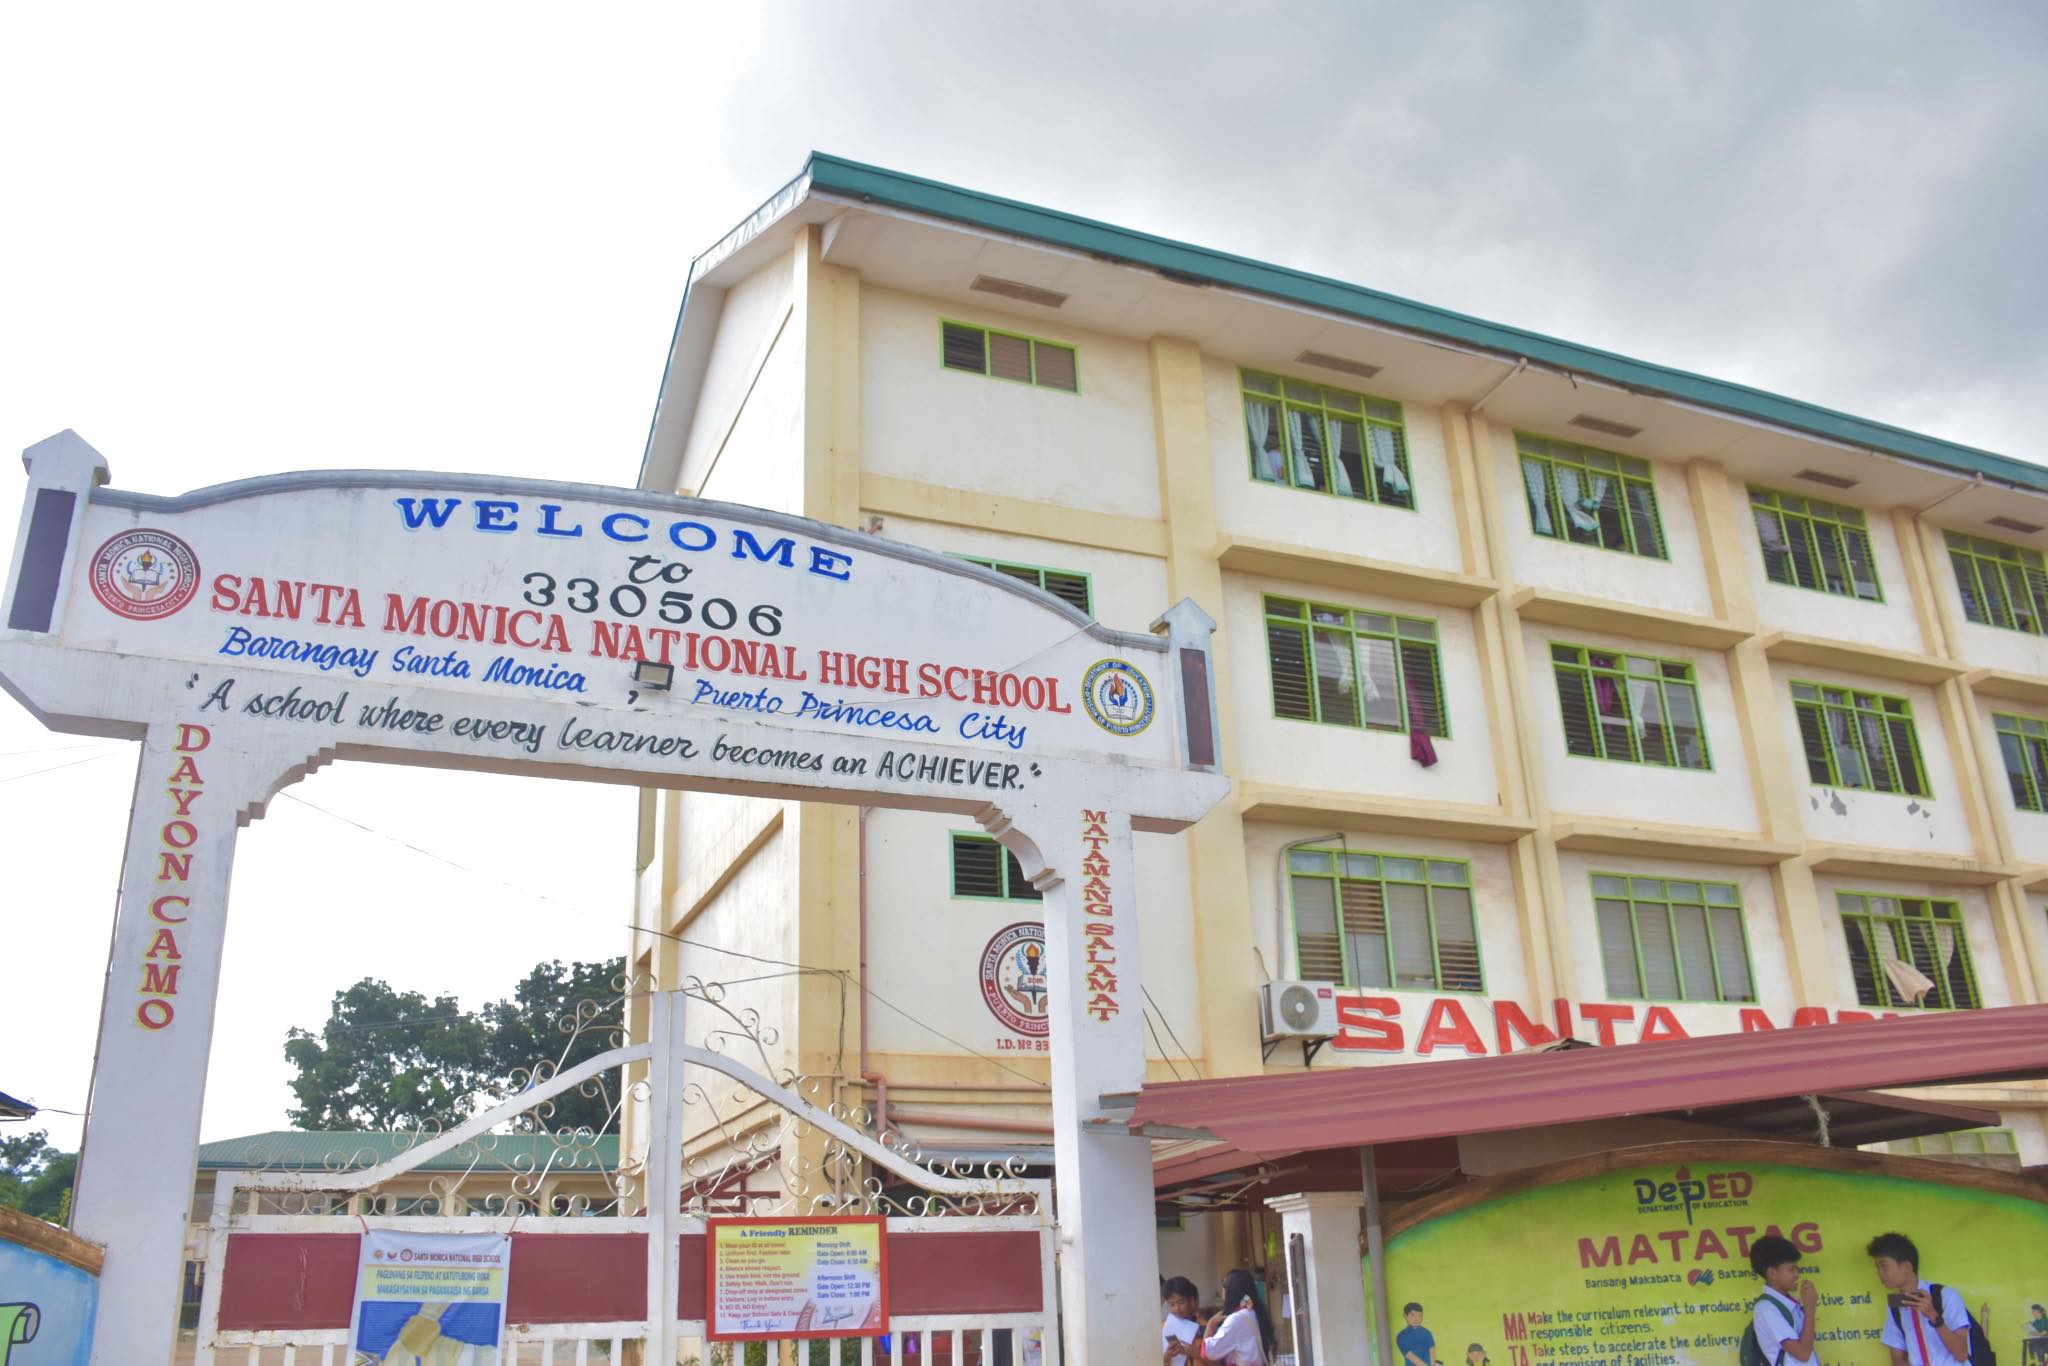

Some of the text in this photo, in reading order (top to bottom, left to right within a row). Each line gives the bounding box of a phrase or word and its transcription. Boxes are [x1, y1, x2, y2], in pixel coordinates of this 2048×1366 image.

[104, 538, 131, 561] MONICA
[131, 534, 173, 549] NATIONAL
[396, 497, 854, 582] WELCOME
[628, 554, 693, 586] to
[522, 571, 784, 638] 330506
[210, 573, 1073, 717] SANTA MONICA NATIONAL HIGH SCHOOL
[218, 626, 589, 694] Barangay Santa Monica
[244, 684, 350, 725] school
[358, 696, 446, 736] where
[452, 713, 547, 754] every
[558, 717, 700, 760] learner
[711, 738, 824, 776] becomes
[831, 753, 868, 777] an
[691, 678, 1028, 751] Puerto Princesa City
[157, 722, 212, 882] DAYON
[1081, 808, 1113, 917] MATAMANG
[136, 894, 191, 1031] CAMO
[985, 952, 998, 981] SANTA
[993, 931, 1018, 954] MONICA
[1085, 922, 1120, 1023] SALAMAT
[989, 992, 1050, 1032] PUERTO PRINC
[1330, 996, 1690, 1056] SANTA
[1633, 1171, 1754, 1226] DepED
[1637, 1203, 1684, 1214] DEPARTMENT
[1702, 1199, 1749, 1209] EDUCATION
[749, 1229, 788, 1238] Friendly
[788, 1226, 838, 1237] REMINDER
[817, 1241, 838, 1249] Morning
[1577, 1221, 1824, 1269] MATATG
[1585, 1277, 1627, 1290] Bansang
[1629, 1273, 1682, 1286] Makabata
[1503, 1312, 1527, 1341] MA
[1527, 1291, 1872, 1326] Make the curriculum relevant to produce and
[1530, 1320, 1655, 1342] responsible citizens.
[1531, 1326, 1862, 1359] Take steps to accelerate the delivery ucation
